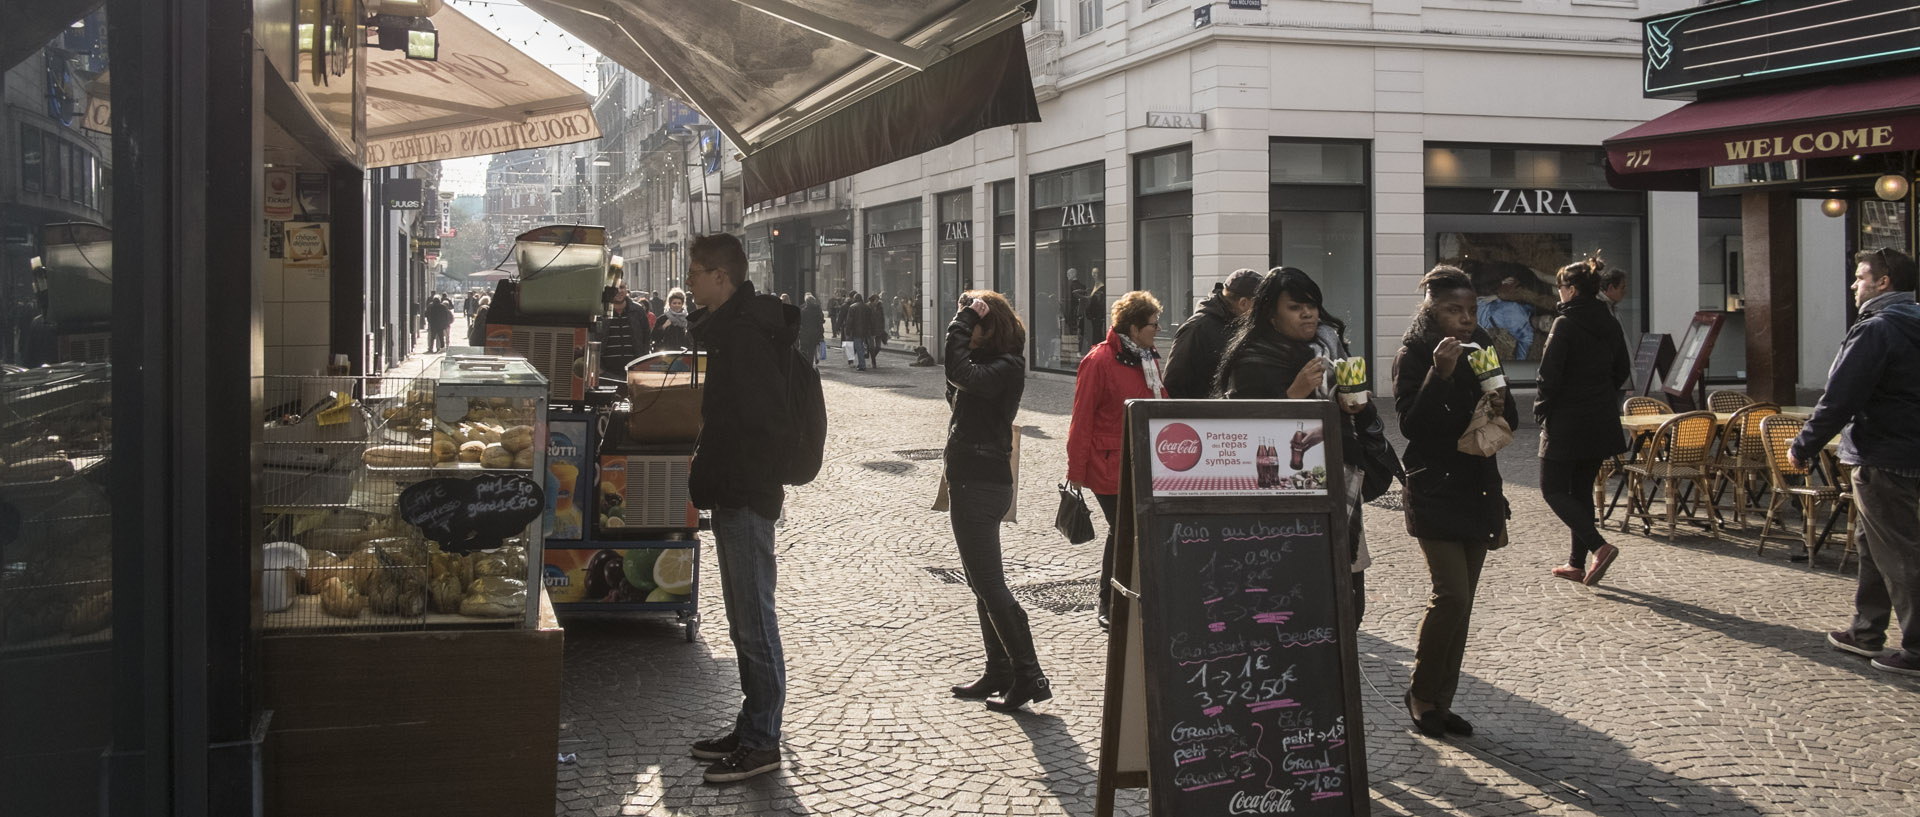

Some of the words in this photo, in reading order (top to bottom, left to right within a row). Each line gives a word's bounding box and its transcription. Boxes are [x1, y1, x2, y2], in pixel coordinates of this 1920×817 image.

[1151, 114, 1194, 128] ZARA
[1625, 149, 1652, 168] 7/7
[1724, 125, 1894, 160] WELCOME
[1492, 189, 1579, 214] ZARA
[1061, 203, 1096, 227] ZARA
[946, 221, 969, 240] ZARA
[869, 233, 886, 248] ZARA
[1206, 432, 1248, 441] Partagez
[1158, 439, 1200, 454] Coca-Cola
[1218, 449, 1237, 458] plus
[1221, 441, 1248, 450] repas
[1205, 458, 1241, 466] sympas
[1187, 663, 1208, 688] 1
[1193, 691, 1214, 708] 3
[1173, 742, 1209, 767] petit
[1229, 788, 1292, 815] Coca-Cola
